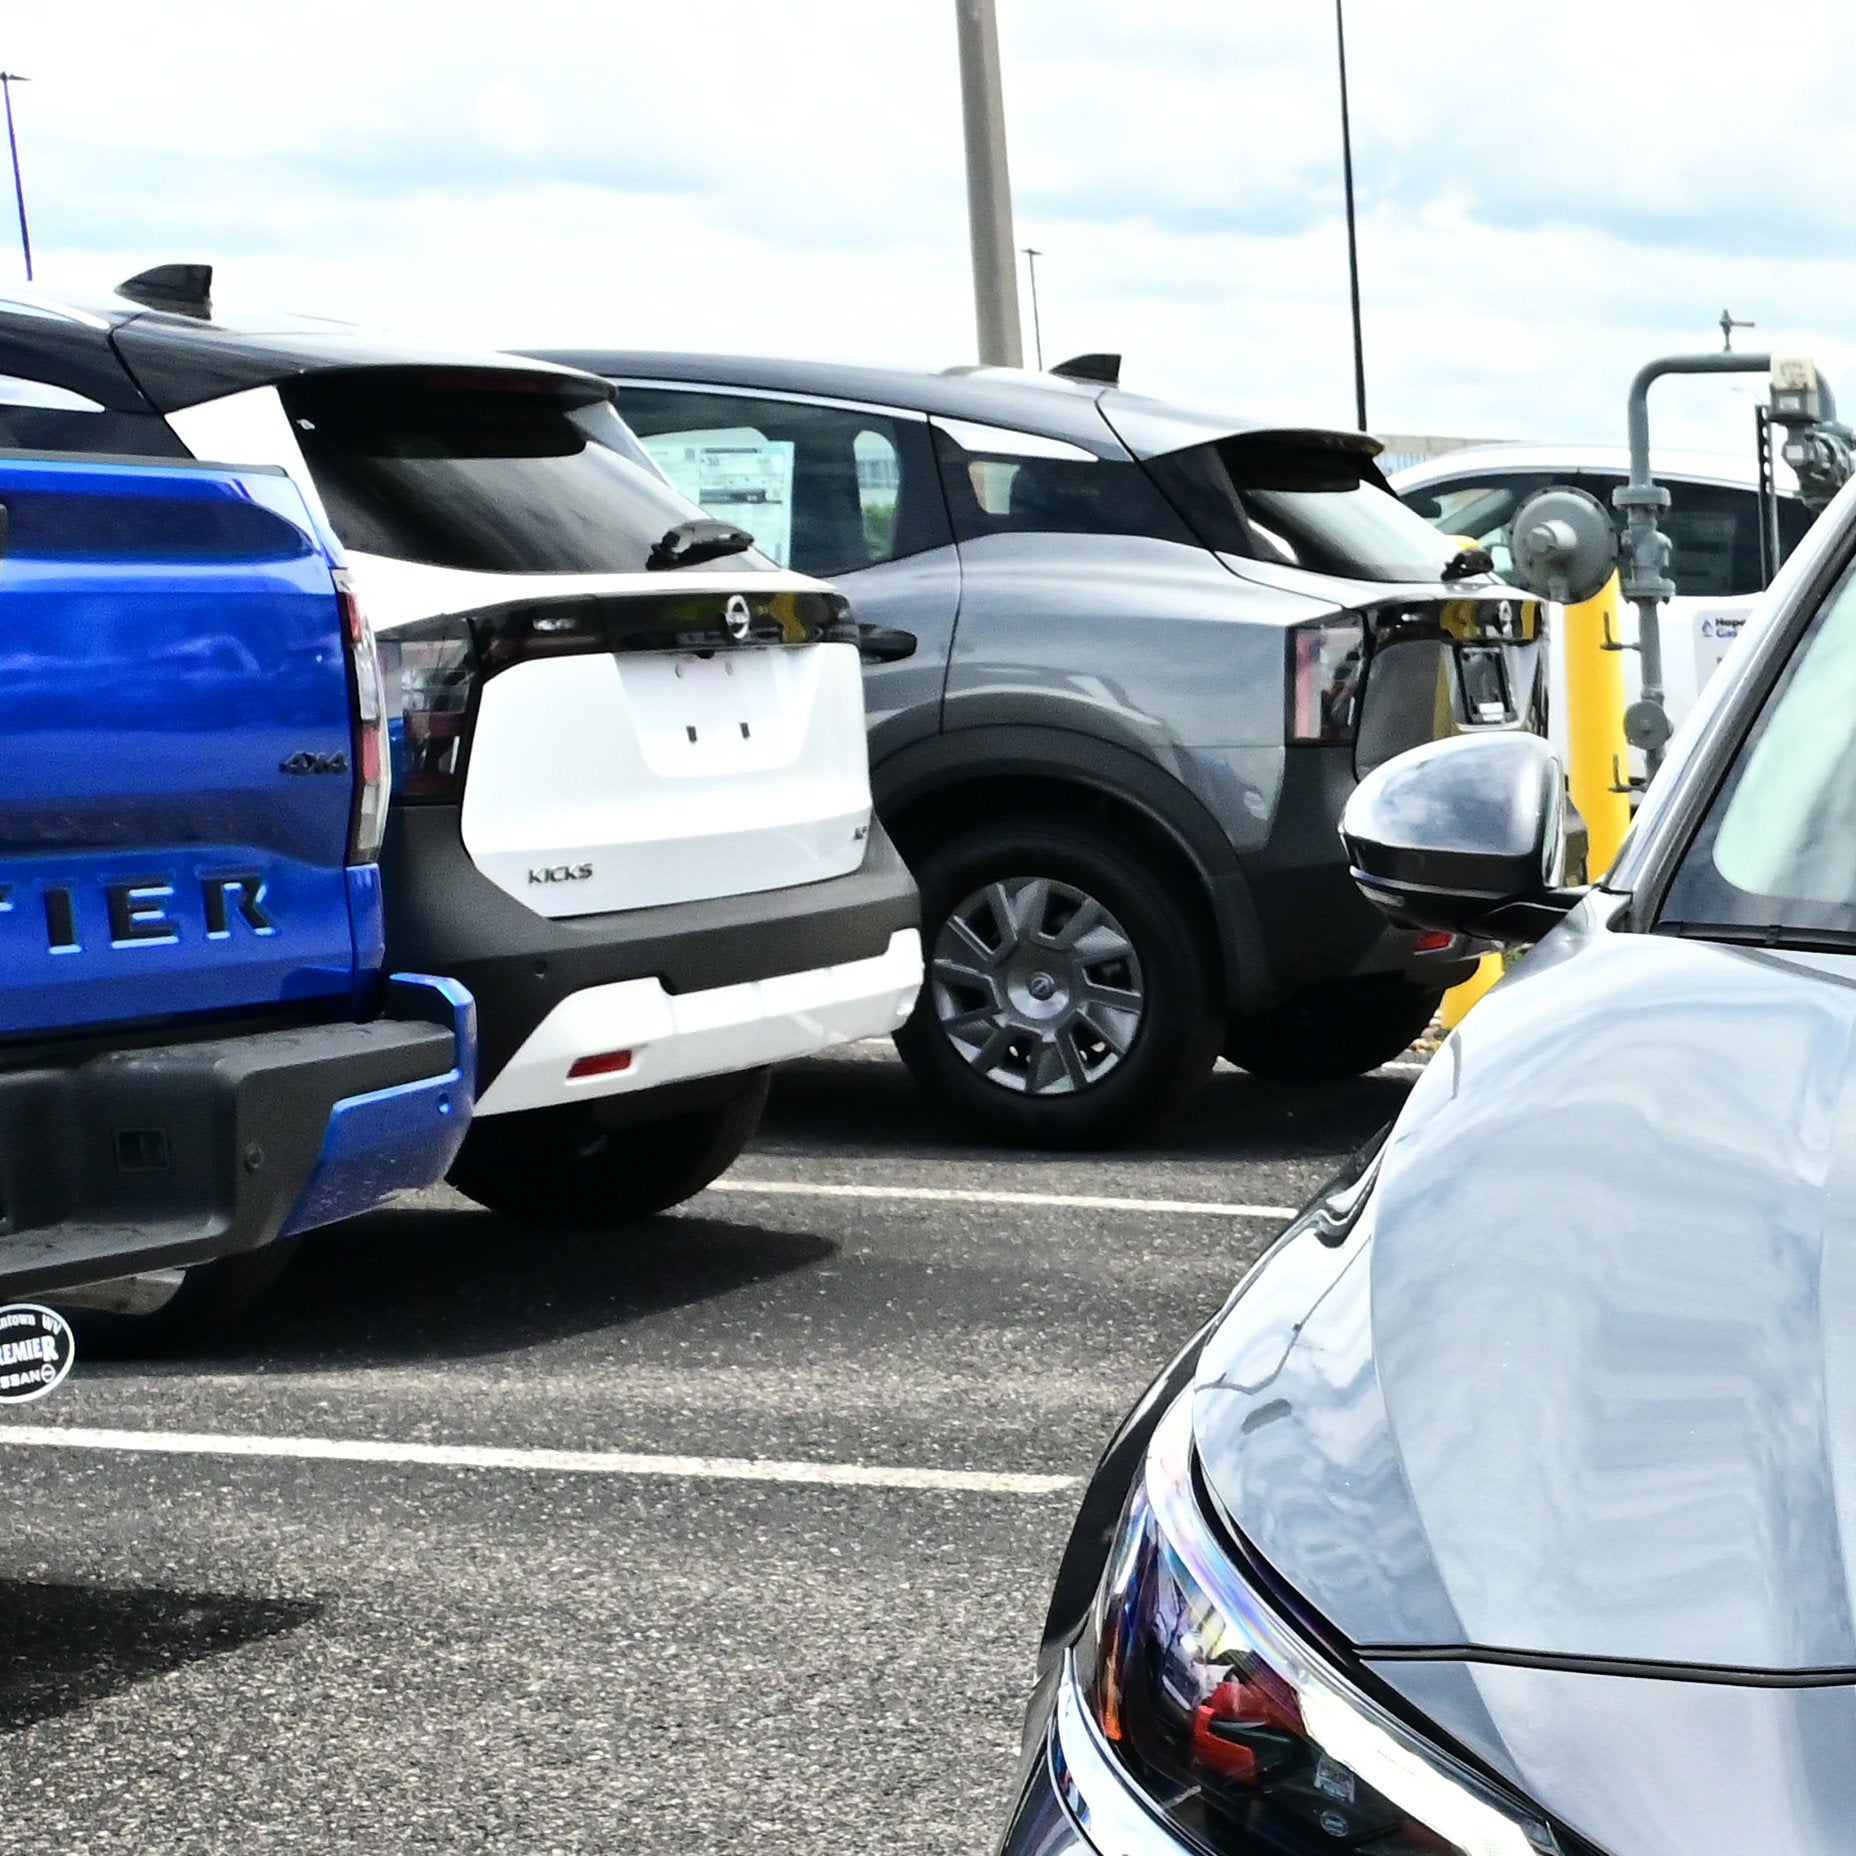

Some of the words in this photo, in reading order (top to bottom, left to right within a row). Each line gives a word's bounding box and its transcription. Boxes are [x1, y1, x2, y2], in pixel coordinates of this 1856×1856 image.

[528, 863, 593, 884] KICKS
[0, 868, 276, 955] IER
[0, 1369, 41, 1390] SSAN
